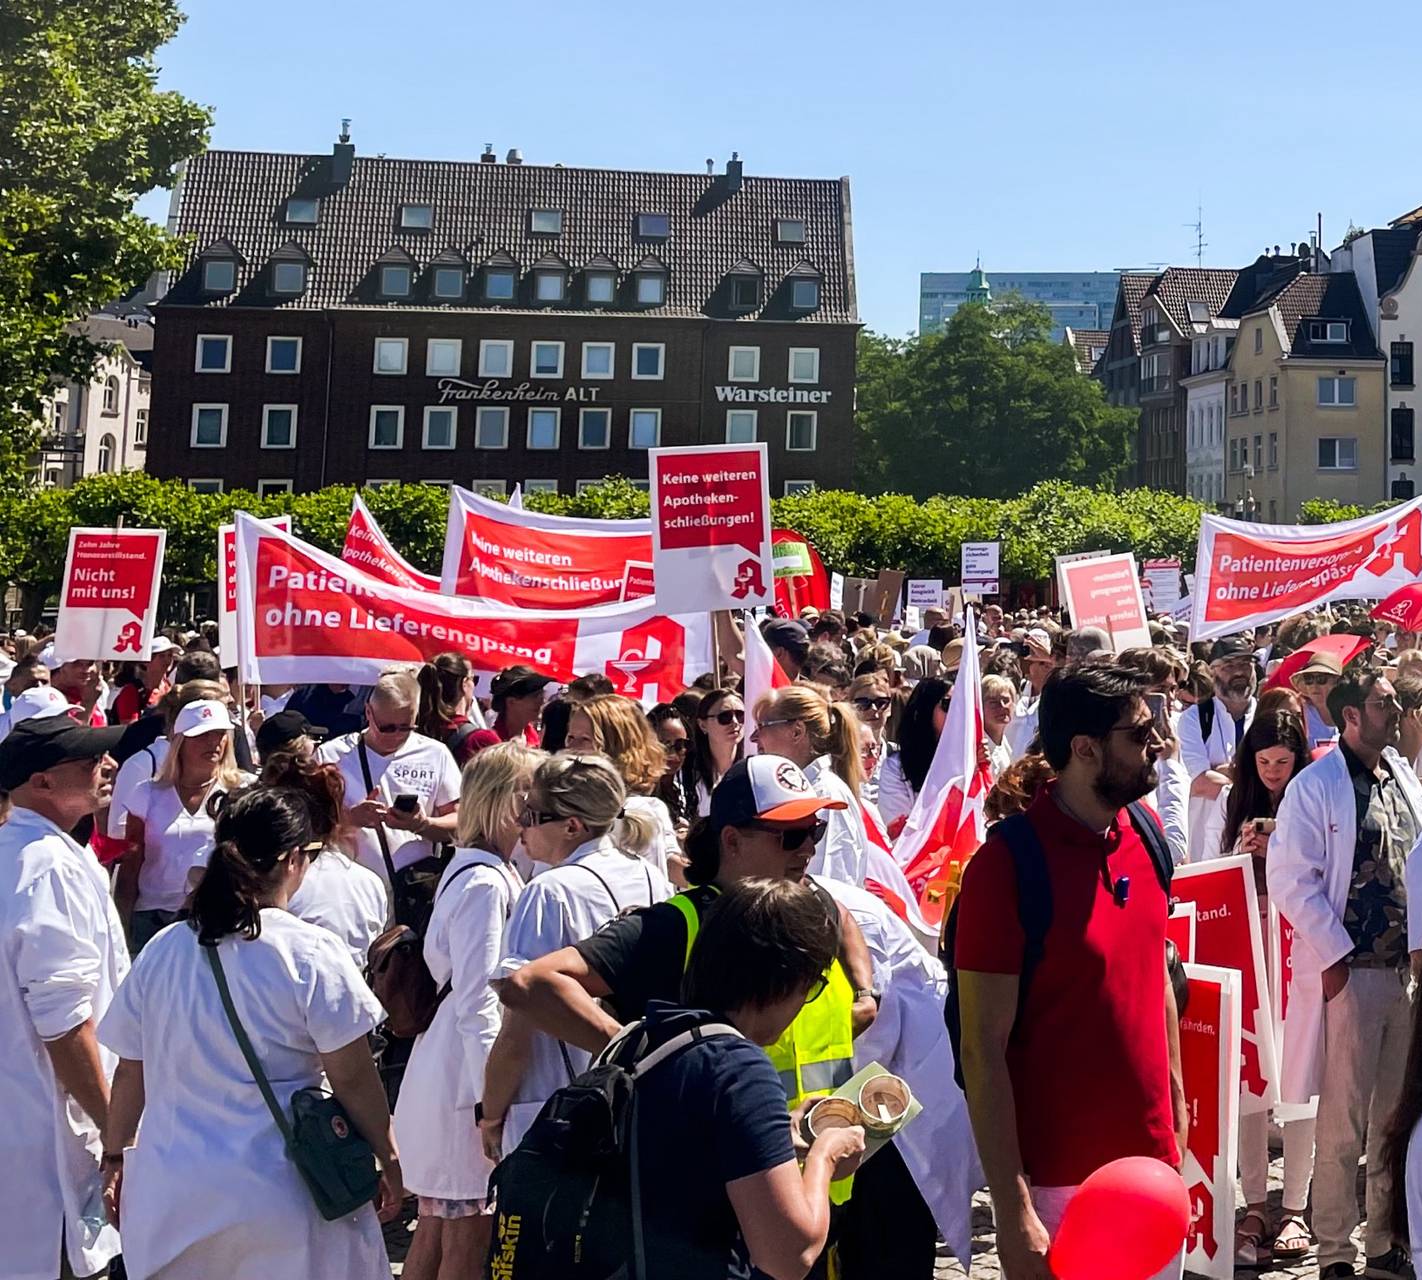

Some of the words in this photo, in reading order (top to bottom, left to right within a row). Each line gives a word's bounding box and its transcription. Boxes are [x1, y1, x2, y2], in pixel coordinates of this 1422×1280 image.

[437, 377, 560, 404] Frankenheim
[563, 387, 601, 401] ALT
[715, 385, 832, 404] Warsteiner
[662, 473, 700, 485] Keine
[702, 470, 757, 483] weiteren
[663, 493, 739, 508] Apotheken-
[664, 511, 755, 529] schließungen!
[502, 547, 573, 567] weiteren
[74, 568, 116, 582] Nicht
[71, 584, 98, 598] mit
[101, 586, 136, 600] uns!
[1215, 583, 1260, 600] ohne
[265, 602, 342, 627] ohne
[394, 769, 435, 779] SPORT
